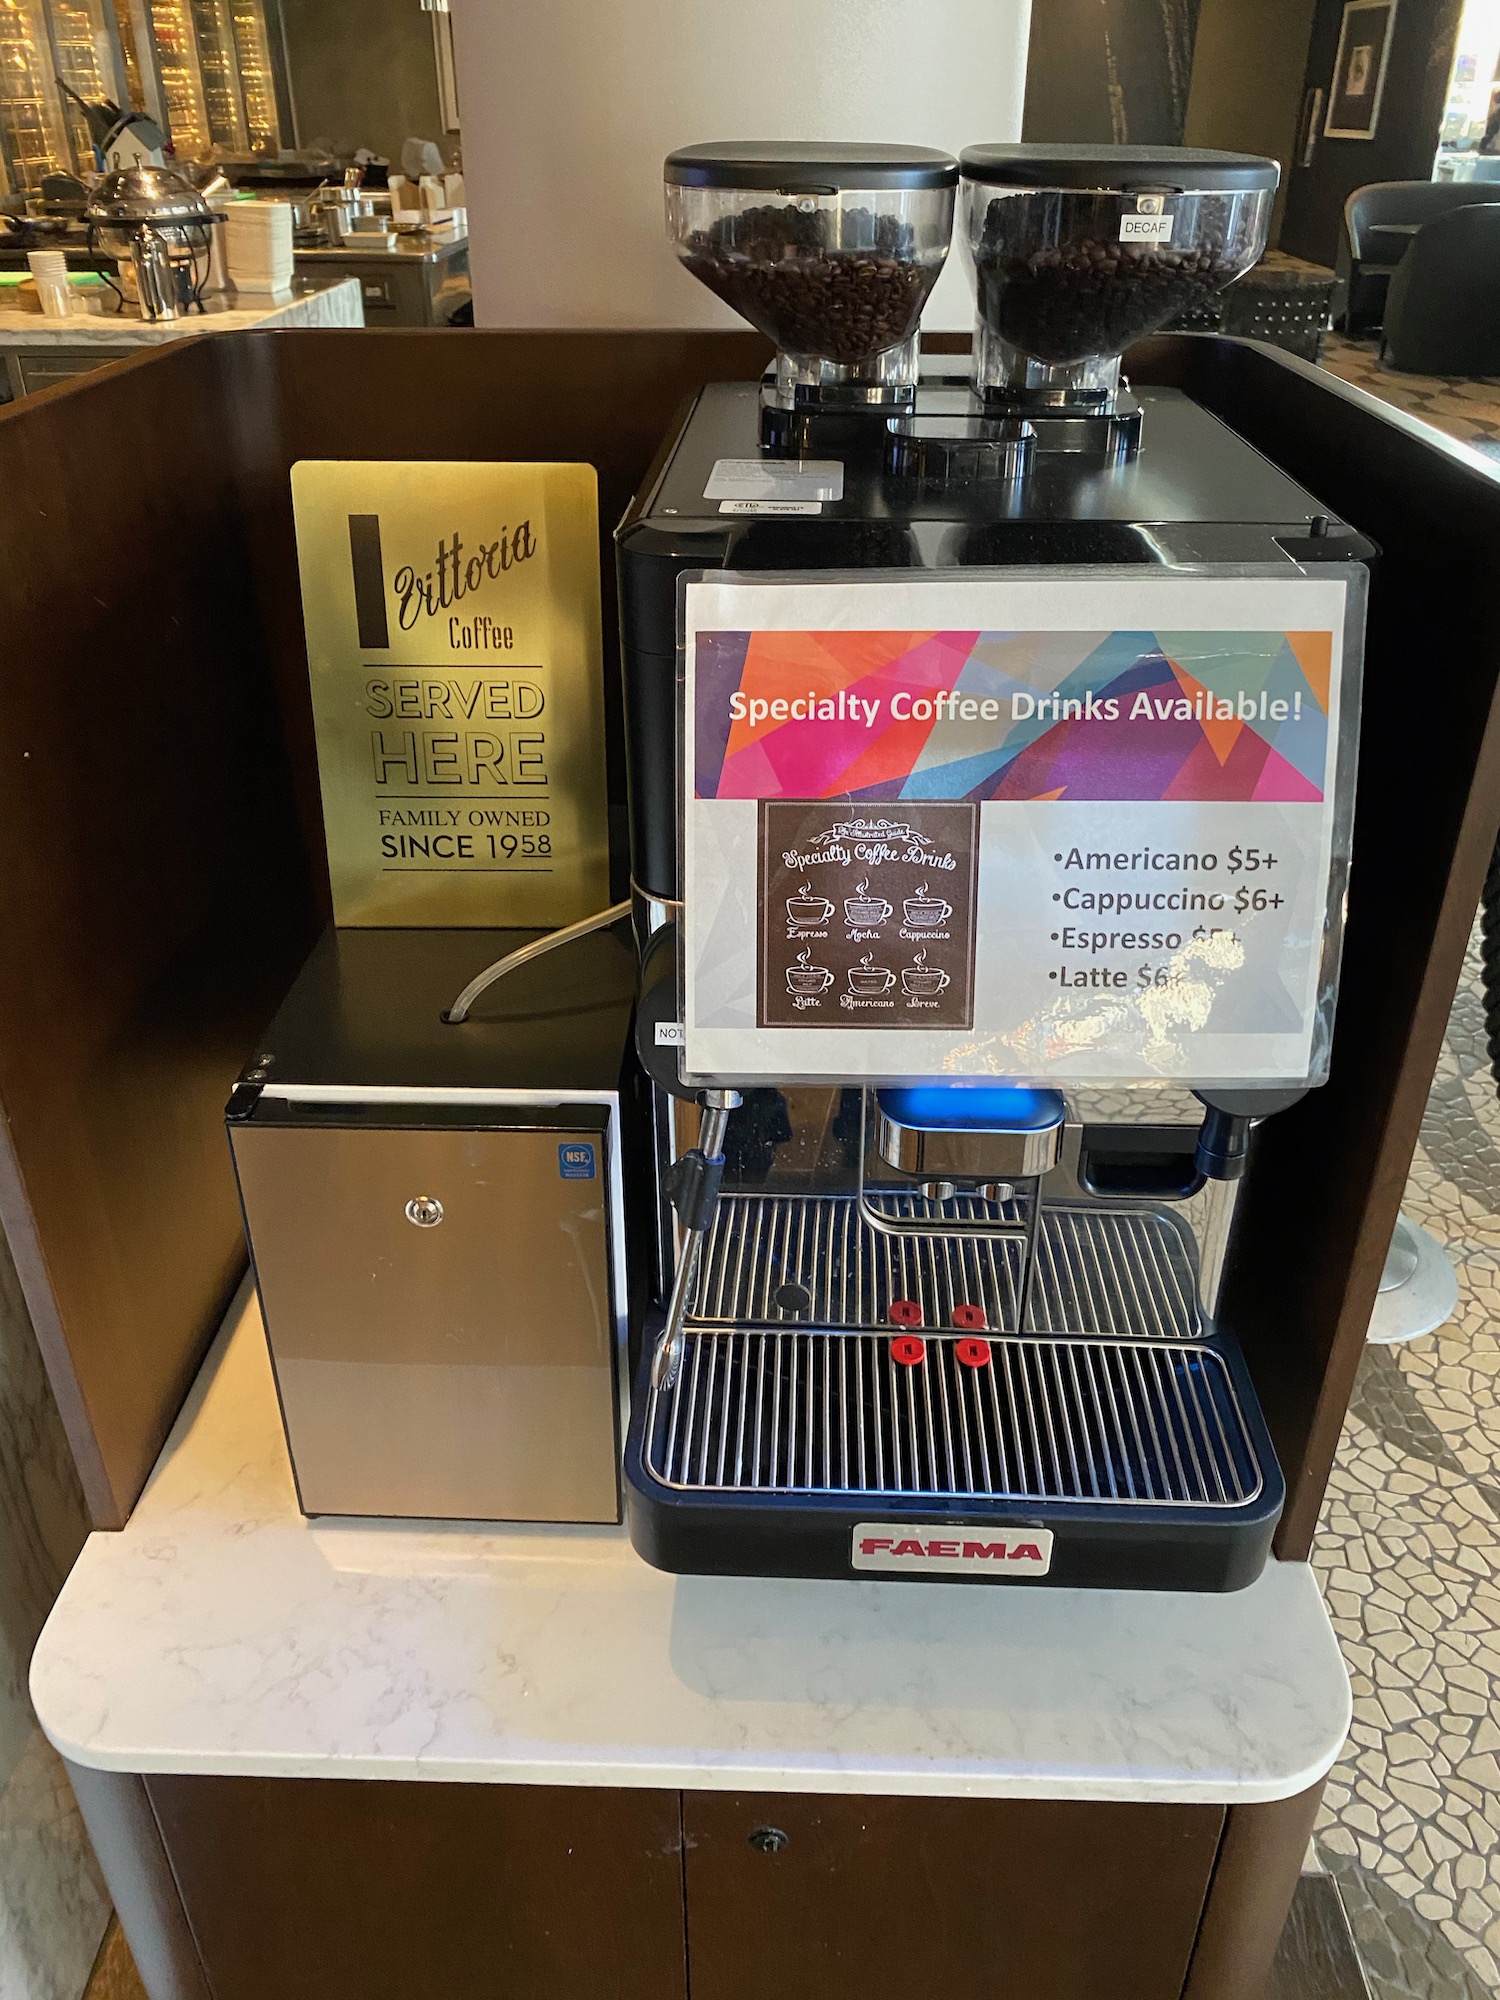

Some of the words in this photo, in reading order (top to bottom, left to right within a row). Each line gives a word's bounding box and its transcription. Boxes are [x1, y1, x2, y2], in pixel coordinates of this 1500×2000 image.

[1125, 222, 1167, 234] DECAF
[393, 519, 537, 631] Vittoria
[448, 616, 514, 650] Coffee
[365, 680, 545, 719] SERVED
[728, 690, 880, 727] Specialty
[890, 690, 999, 722] Coffee
[1011, 690, 1120, 721] Drinks
[1128, 690, 1302, 722] Available!
[371, 731, 548, 785] HERE
[379, 810, 461, 827] FAMILY
[468, 810, 551, 827] OWNED
[381, 835, 474, 859] SINCE
[486, 834, 552, 859] 1958
[782, 844, 851, 872] Specialty
[854, 843, 900, 866] Coffee
[902, 845, 956, 871] Drinks
[1064, 846, 1218, 871] Americano
[1227, 845, 1278, 875] $5+
[1063, 887, 1225, 914] Cappuccino
[1233, 885, 1284, 914] $6+
[786, 926, 829, 940] Espresso
[846, 928, 881, 943] Mocha
[899, 927, 950, 942] Cappuccino
[1062, 927, 1182, 953] Espresso
[1060, 966, 1128, 987] Latte
[792, 995, 821, 1010] Latte
[839, 994, 895, 1010] Americano
[566, 1151, 587, 1162] NSF
[859, 1538, 1043, 1561] FAEMA
